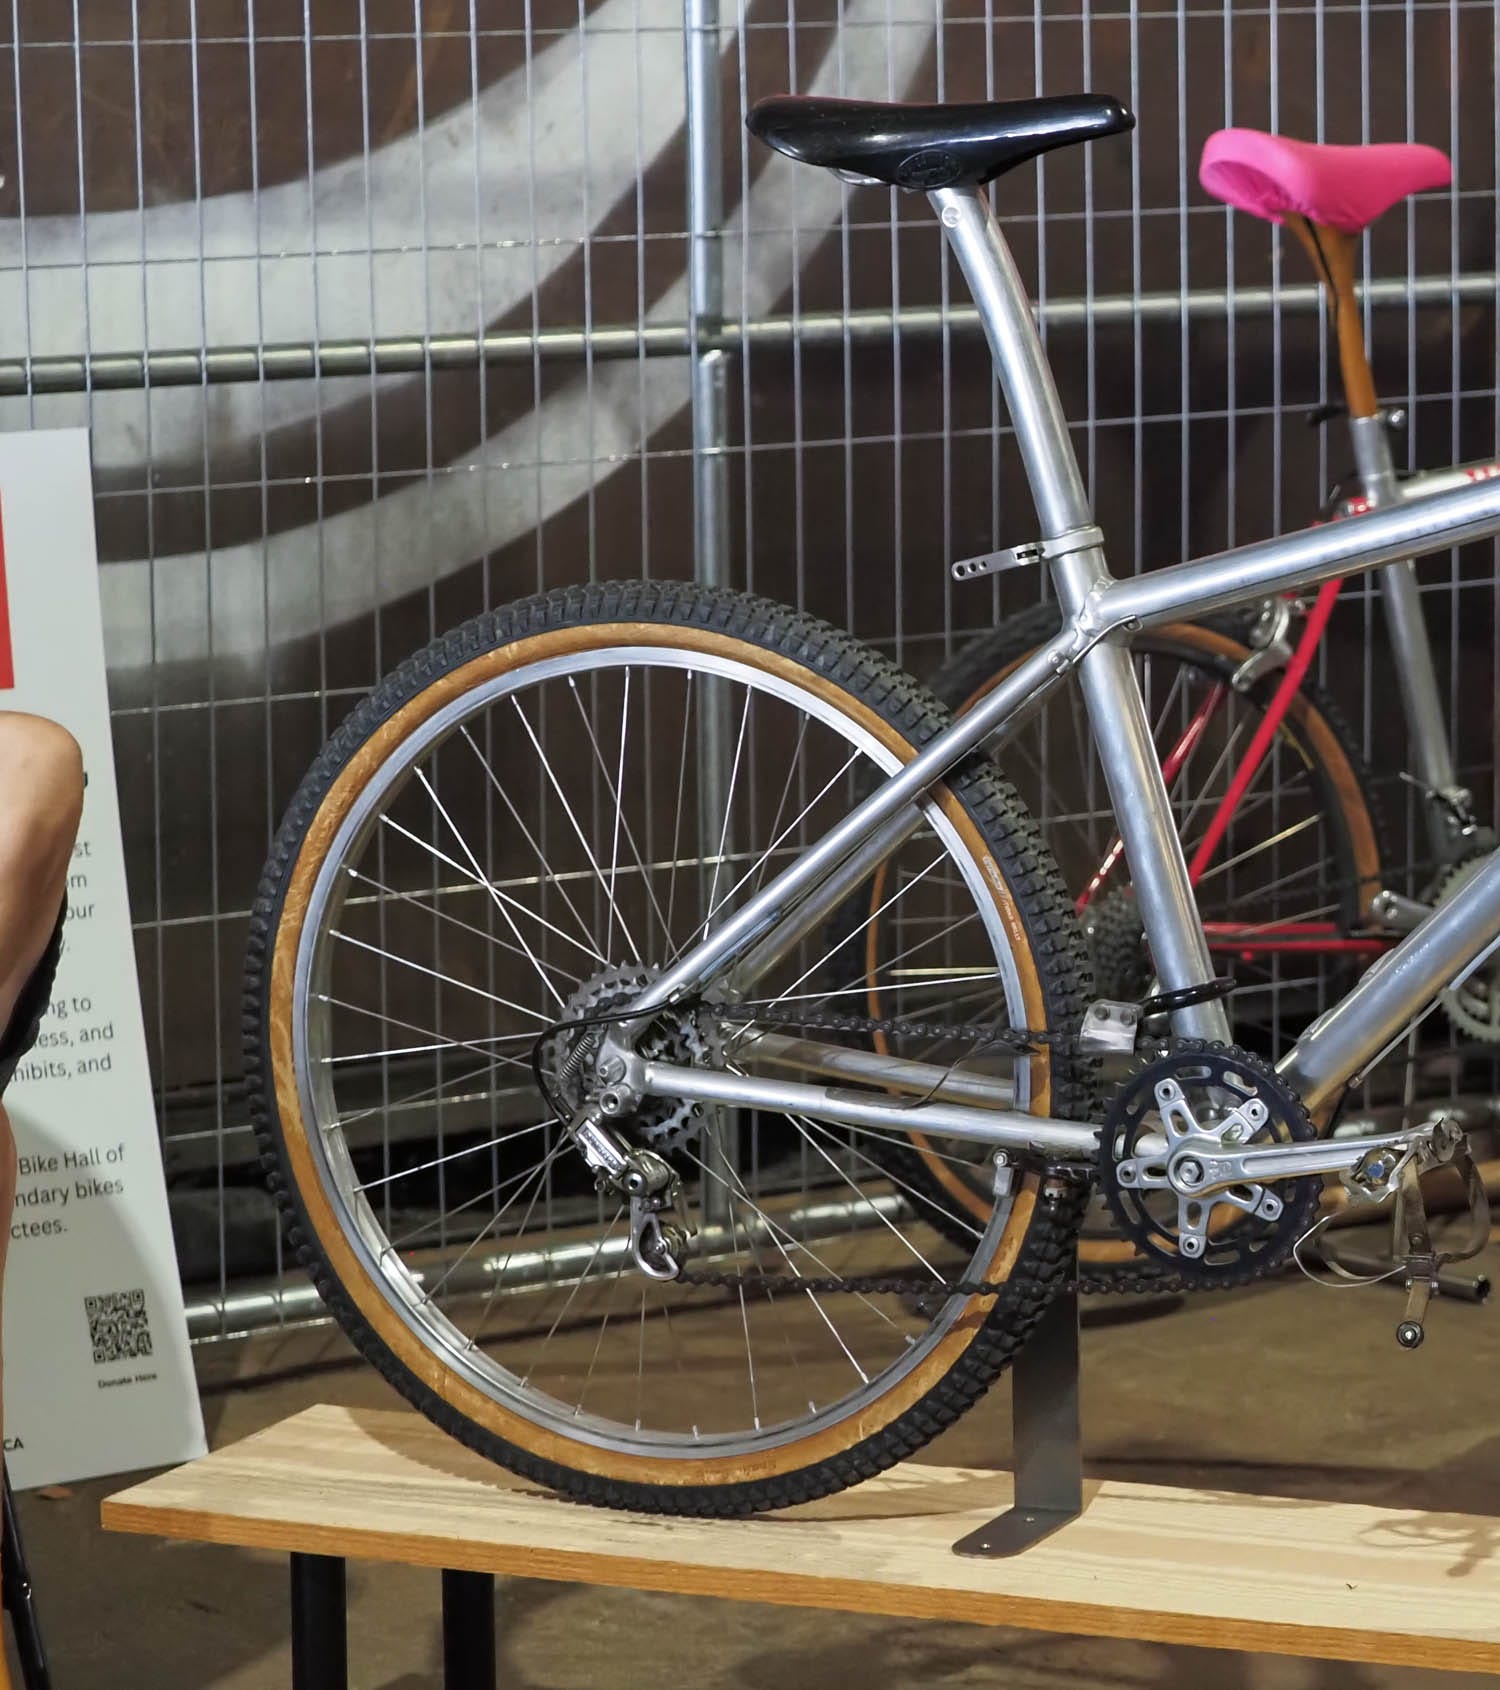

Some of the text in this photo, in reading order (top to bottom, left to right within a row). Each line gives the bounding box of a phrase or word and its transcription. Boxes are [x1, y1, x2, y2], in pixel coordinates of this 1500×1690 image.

[72, 997, 92, 1013] to
[79, 1021, 114, 1043] and
[77, 1053, 112, 1075] and
[18, 1142, 125, 1176] Bike Hall of
[15, 1177, 124, 1208] ndary bikes
[10, 1220, 68, 1240] ctees.
[3, 1437, 24, 1451] CA
